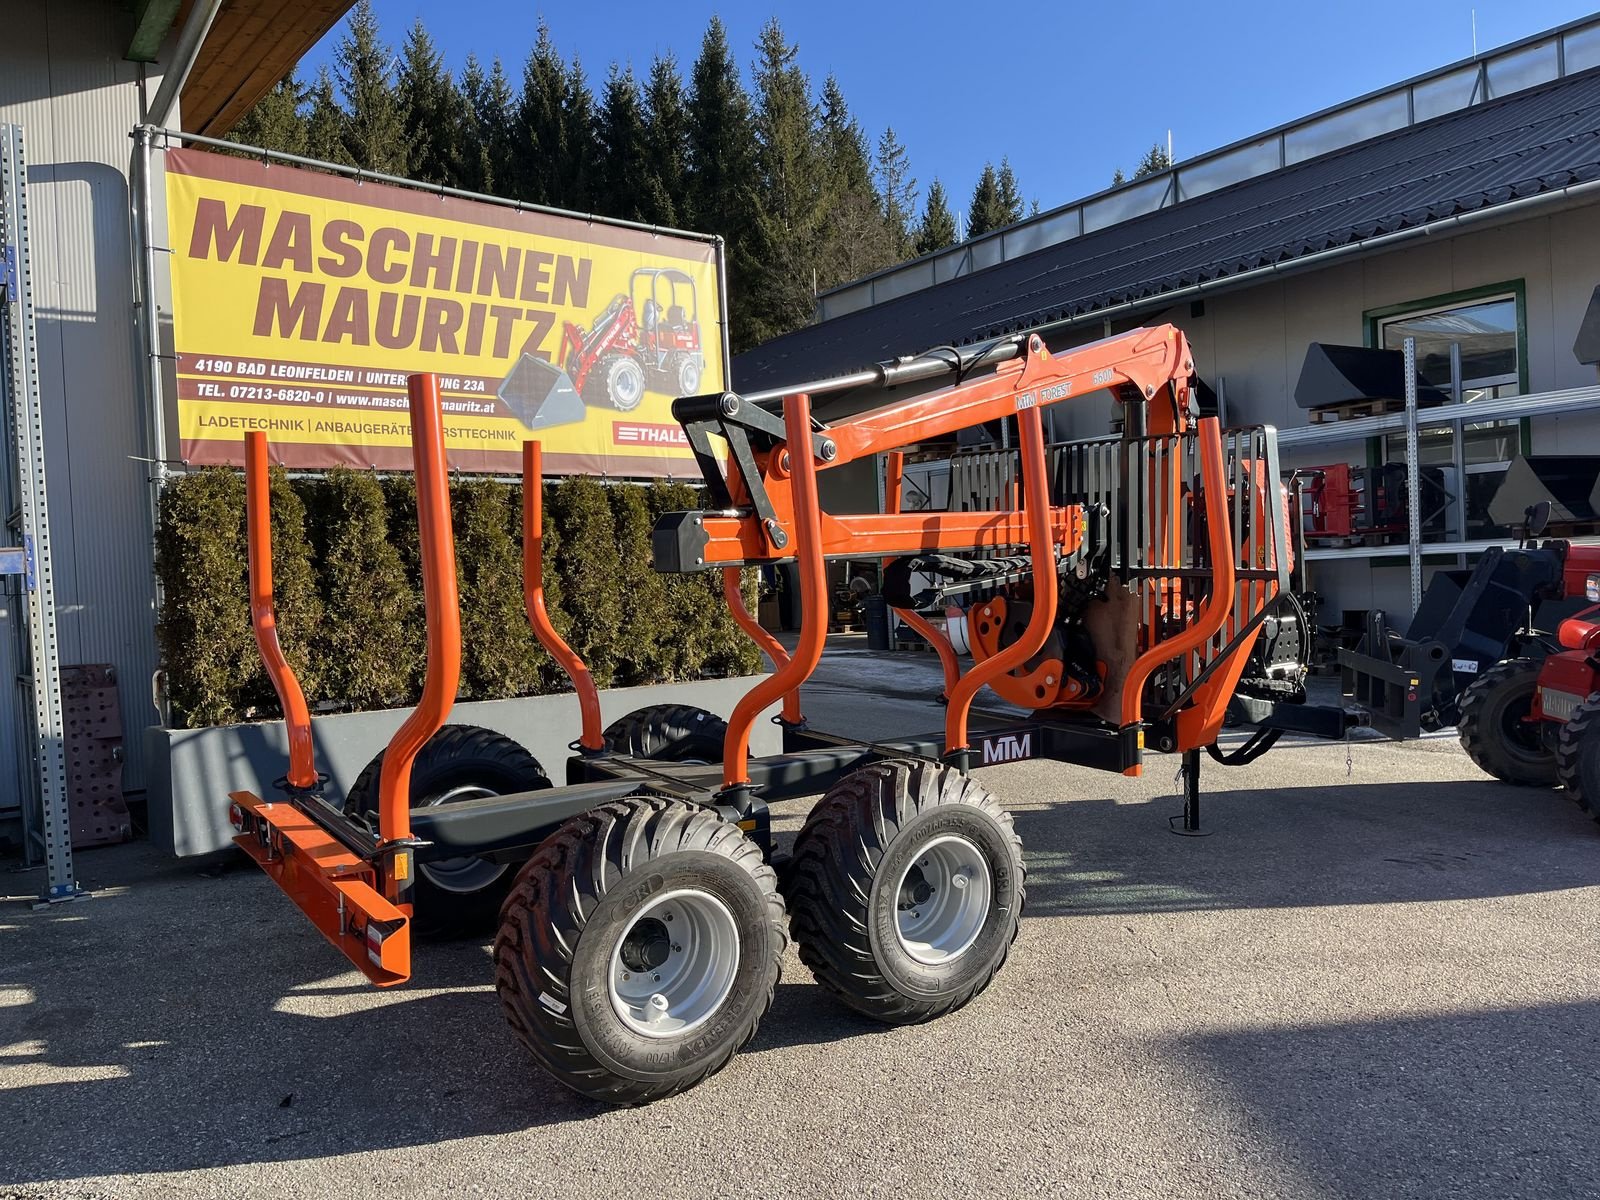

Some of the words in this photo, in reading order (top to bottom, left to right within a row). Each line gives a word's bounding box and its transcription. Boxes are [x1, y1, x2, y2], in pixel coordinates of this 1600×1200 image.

[188, 196, 593, 309] MASCHINEN
[252, 276, 557, 361] MAURITZ
[195, 359, 233, 374] 4190
[237, 361, 267, 376] BAD
[270, 364, 353, 383] LEONFELDEN
[463, 379, 485, 392] 23A
[1016, 393, 1037, 410] MTM
[1040, 382, 1072, 403] FOREST
[1092, 368, 1113, 385] 6600
[197, 383, 225, 398] TEL.
[230, 386, 324, 403] 07213-6820-0
[336, 394, 495, 414] www.maschmauritz.at
[198, 415, 304, 432] LADETECHNIK
[444, 426, 516, 441] RSTTECHNIK
[638, 428, 688, 442] THALE
[983, 733, 1031, 764] MTM
